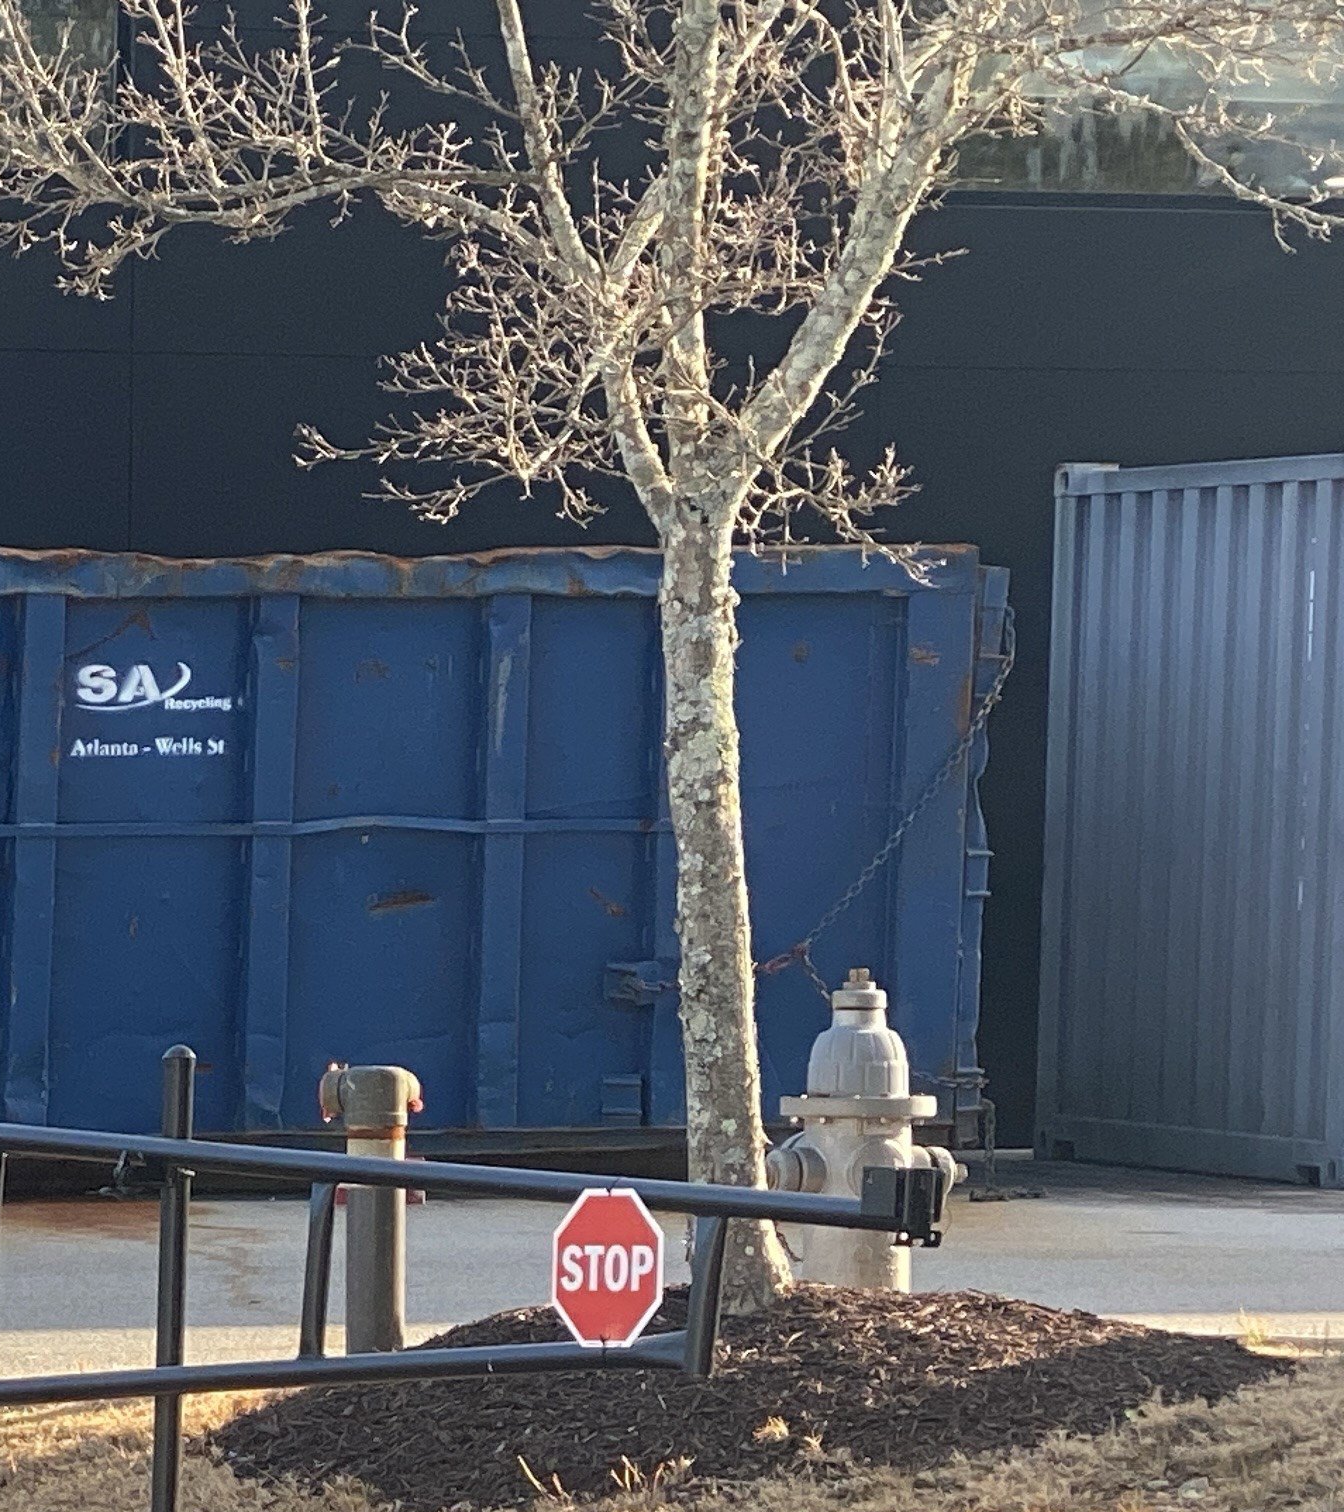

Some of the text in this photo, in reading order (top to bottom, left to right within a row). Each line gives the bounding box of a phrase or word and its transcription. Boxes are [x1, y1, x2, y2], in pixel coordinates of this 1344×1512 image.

[76, 664, 161, 703] SA
[165, 696, 232, 711] Recycling
[70, 738, 139, 757] Atlanta
[155, 737, 202, 756] Wells
[207, 738, 224, 755] St
[560, 1245, 655, 1292] STOP
